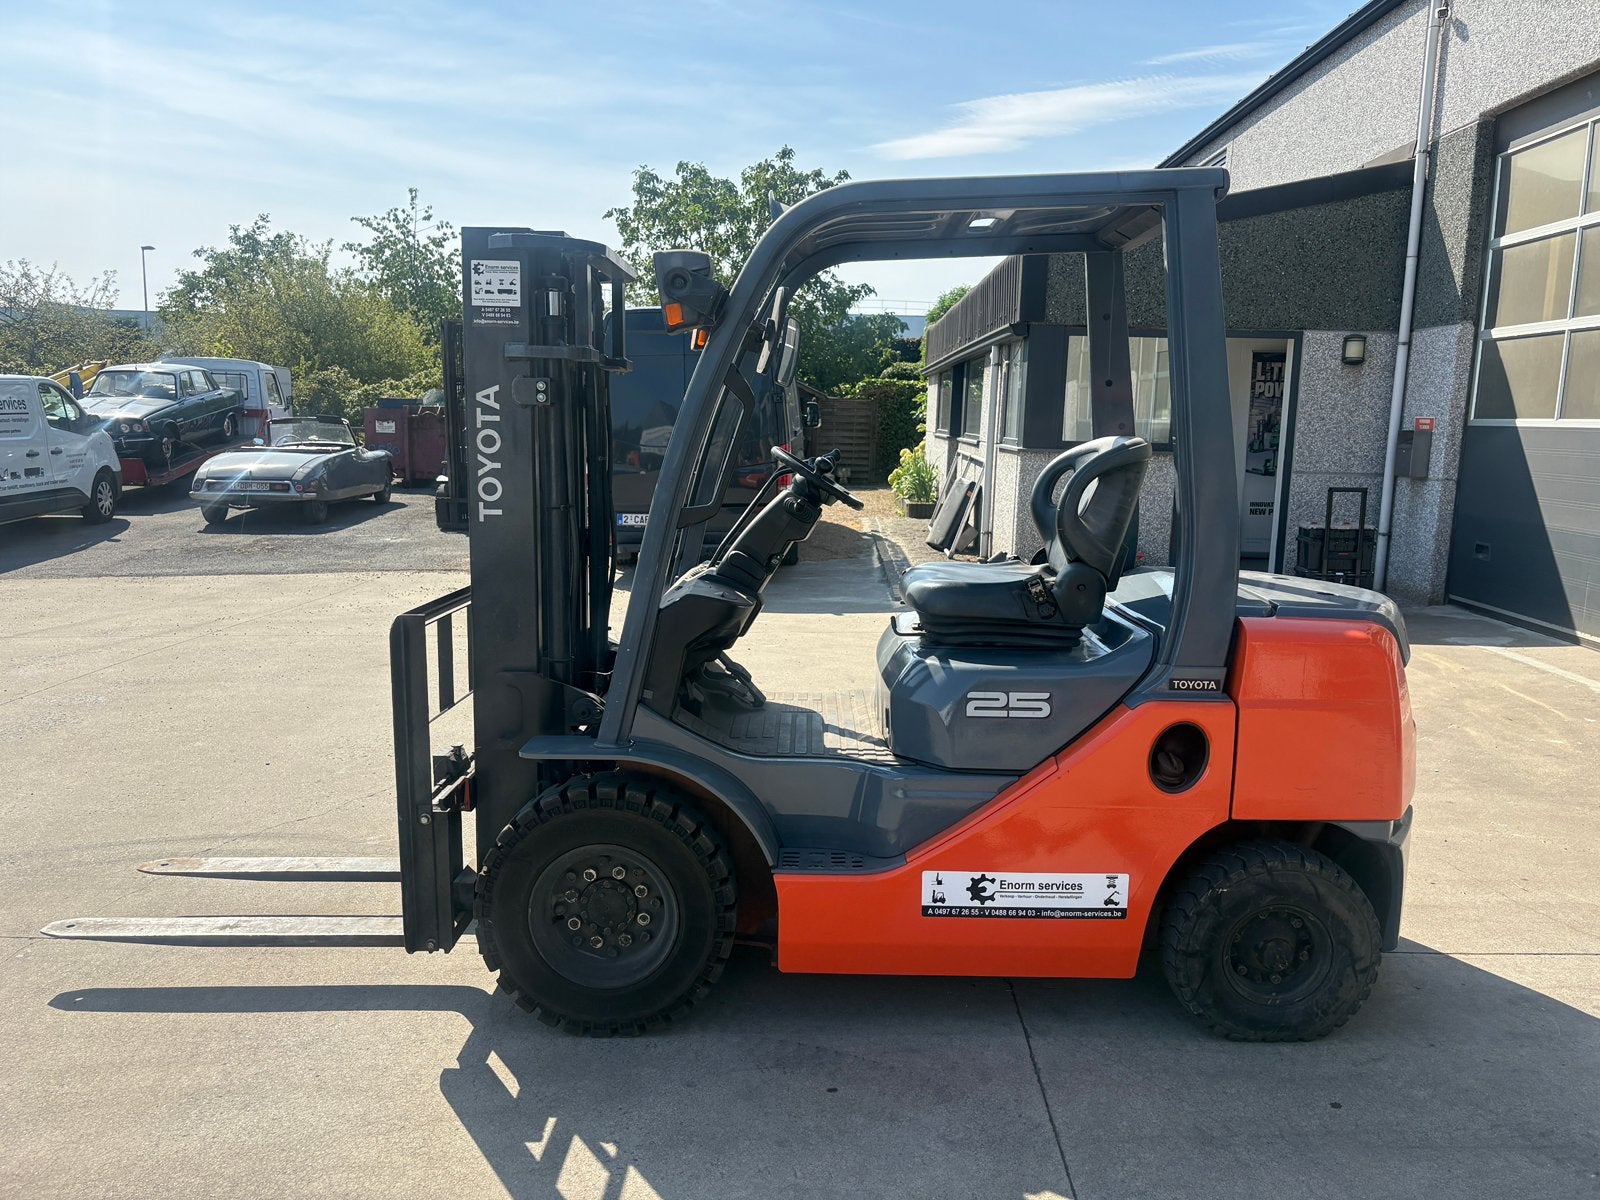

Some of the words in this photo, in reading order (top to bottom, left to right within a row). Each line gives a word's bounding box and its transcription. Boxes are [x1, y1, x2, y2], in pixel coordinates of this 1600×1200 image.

[476, 384, 502, 522] TOYOTA
[1172, 680, 1217, 690] TOYOTA
[966, 691, 1050, 717] 25
[1000, 880, 1034, 890] Enorm
[1038, 881, 1083, 890] services
